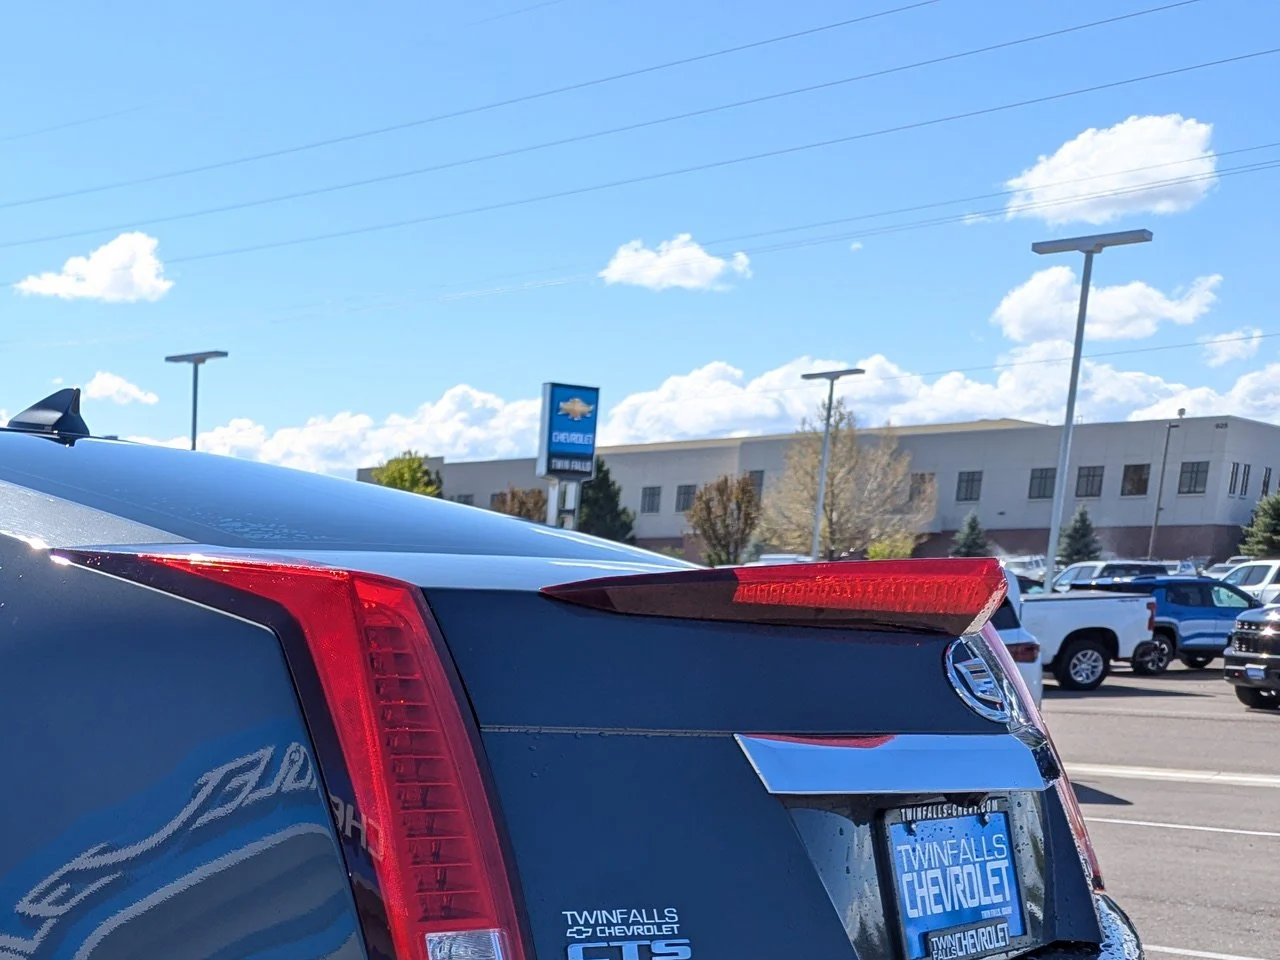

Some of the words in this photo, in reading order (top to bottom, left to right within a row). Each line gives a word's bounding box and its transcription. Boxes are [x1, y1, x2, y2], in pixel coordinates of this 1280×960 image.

[552, 431, 593, 445] CHEVROLET
[896, 833, 1008, 872] TWINFALLS
[901, 859, 1011, 919] CHEVROLET
[562, 908, 679, 925] TWINFALLS
[596, 924, 680, 937] CHEVROLET
[931, 934, 957, 951] TWIN
[955, 922, 1010, 957] CHEVROLET
